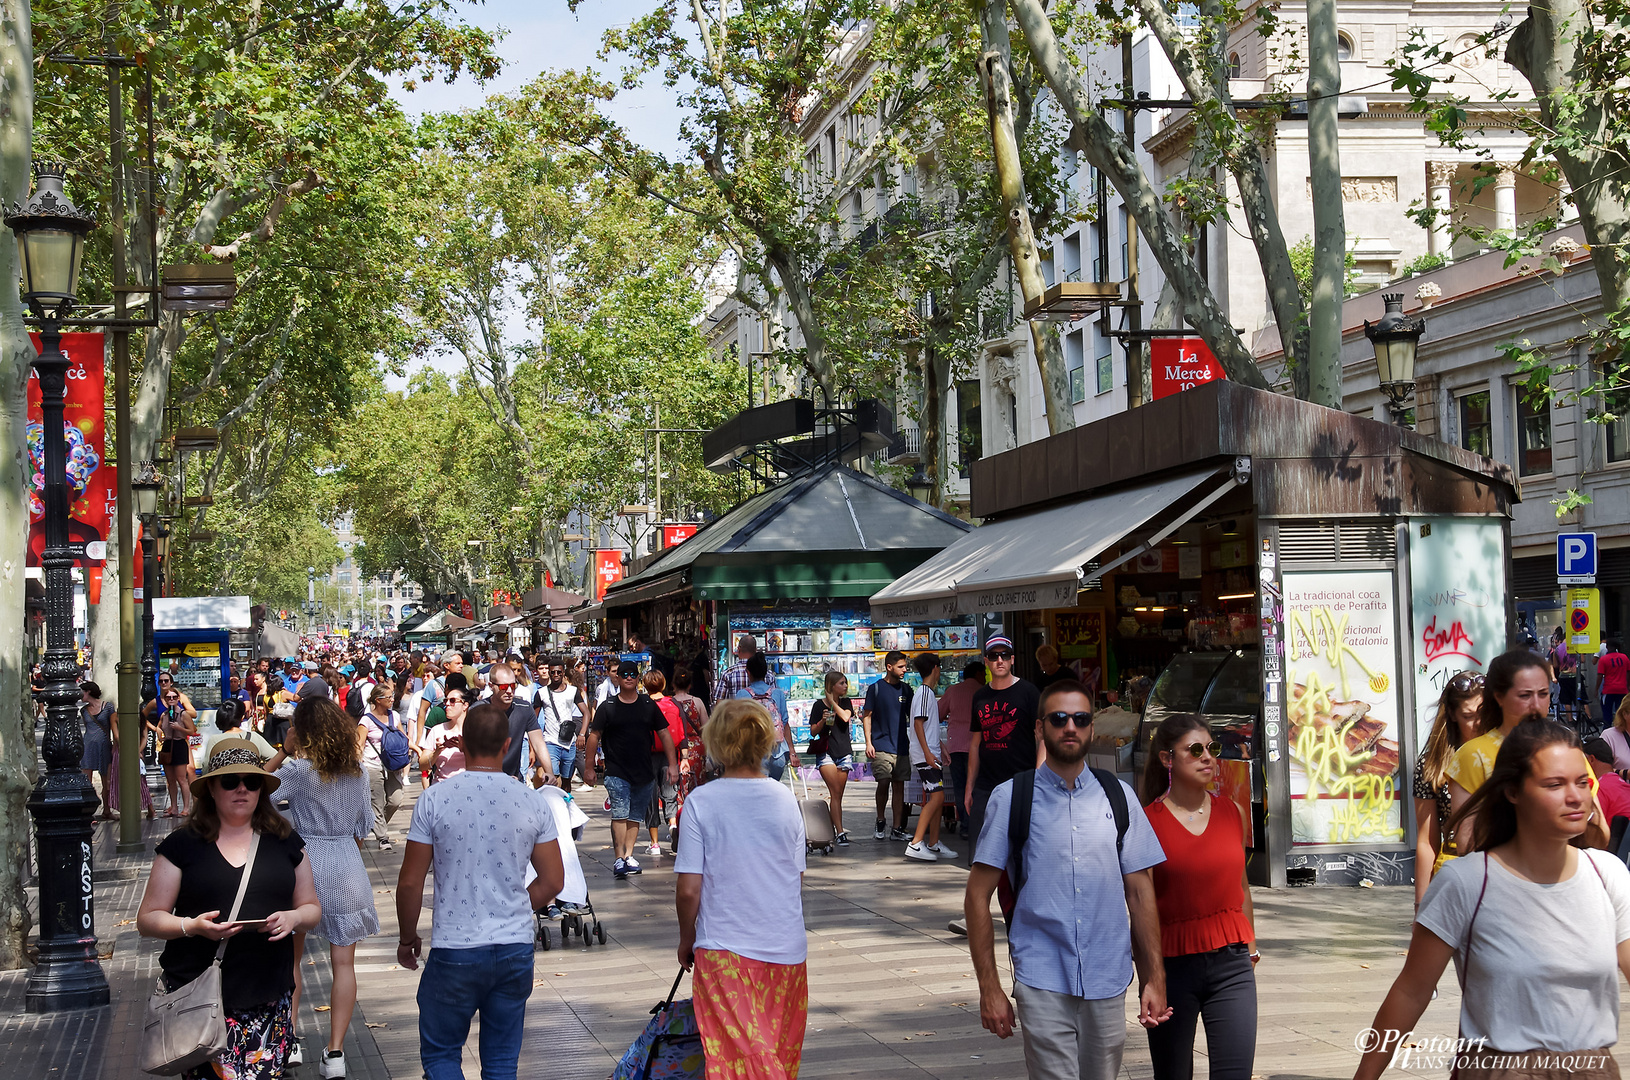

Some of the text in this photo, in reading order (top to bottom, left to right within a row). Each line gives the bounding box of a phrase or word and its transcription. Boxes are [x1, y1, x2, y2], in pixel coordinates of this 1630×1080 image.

[60, 349, 71, 360] a
[1178, 348, 1198, 363] La
[1164, 365, 1212, 380] Mercè
[1420, 523, 1431, 537] 38
[1564, 538, 1587, 571] P
[978, 590, 1037, 607] LOCAL GOURMET FOOD
[1289, 590, 1380, 600] La tradicional coca
[1333, 602, 1346, 611] de
[1349, 601, 1387, 610] Perafita
[1056, 617, 1100, 627] Saffron
[1610, 656, 1623, 668] 10
[978, 700, 1017, 718] OSAKA
